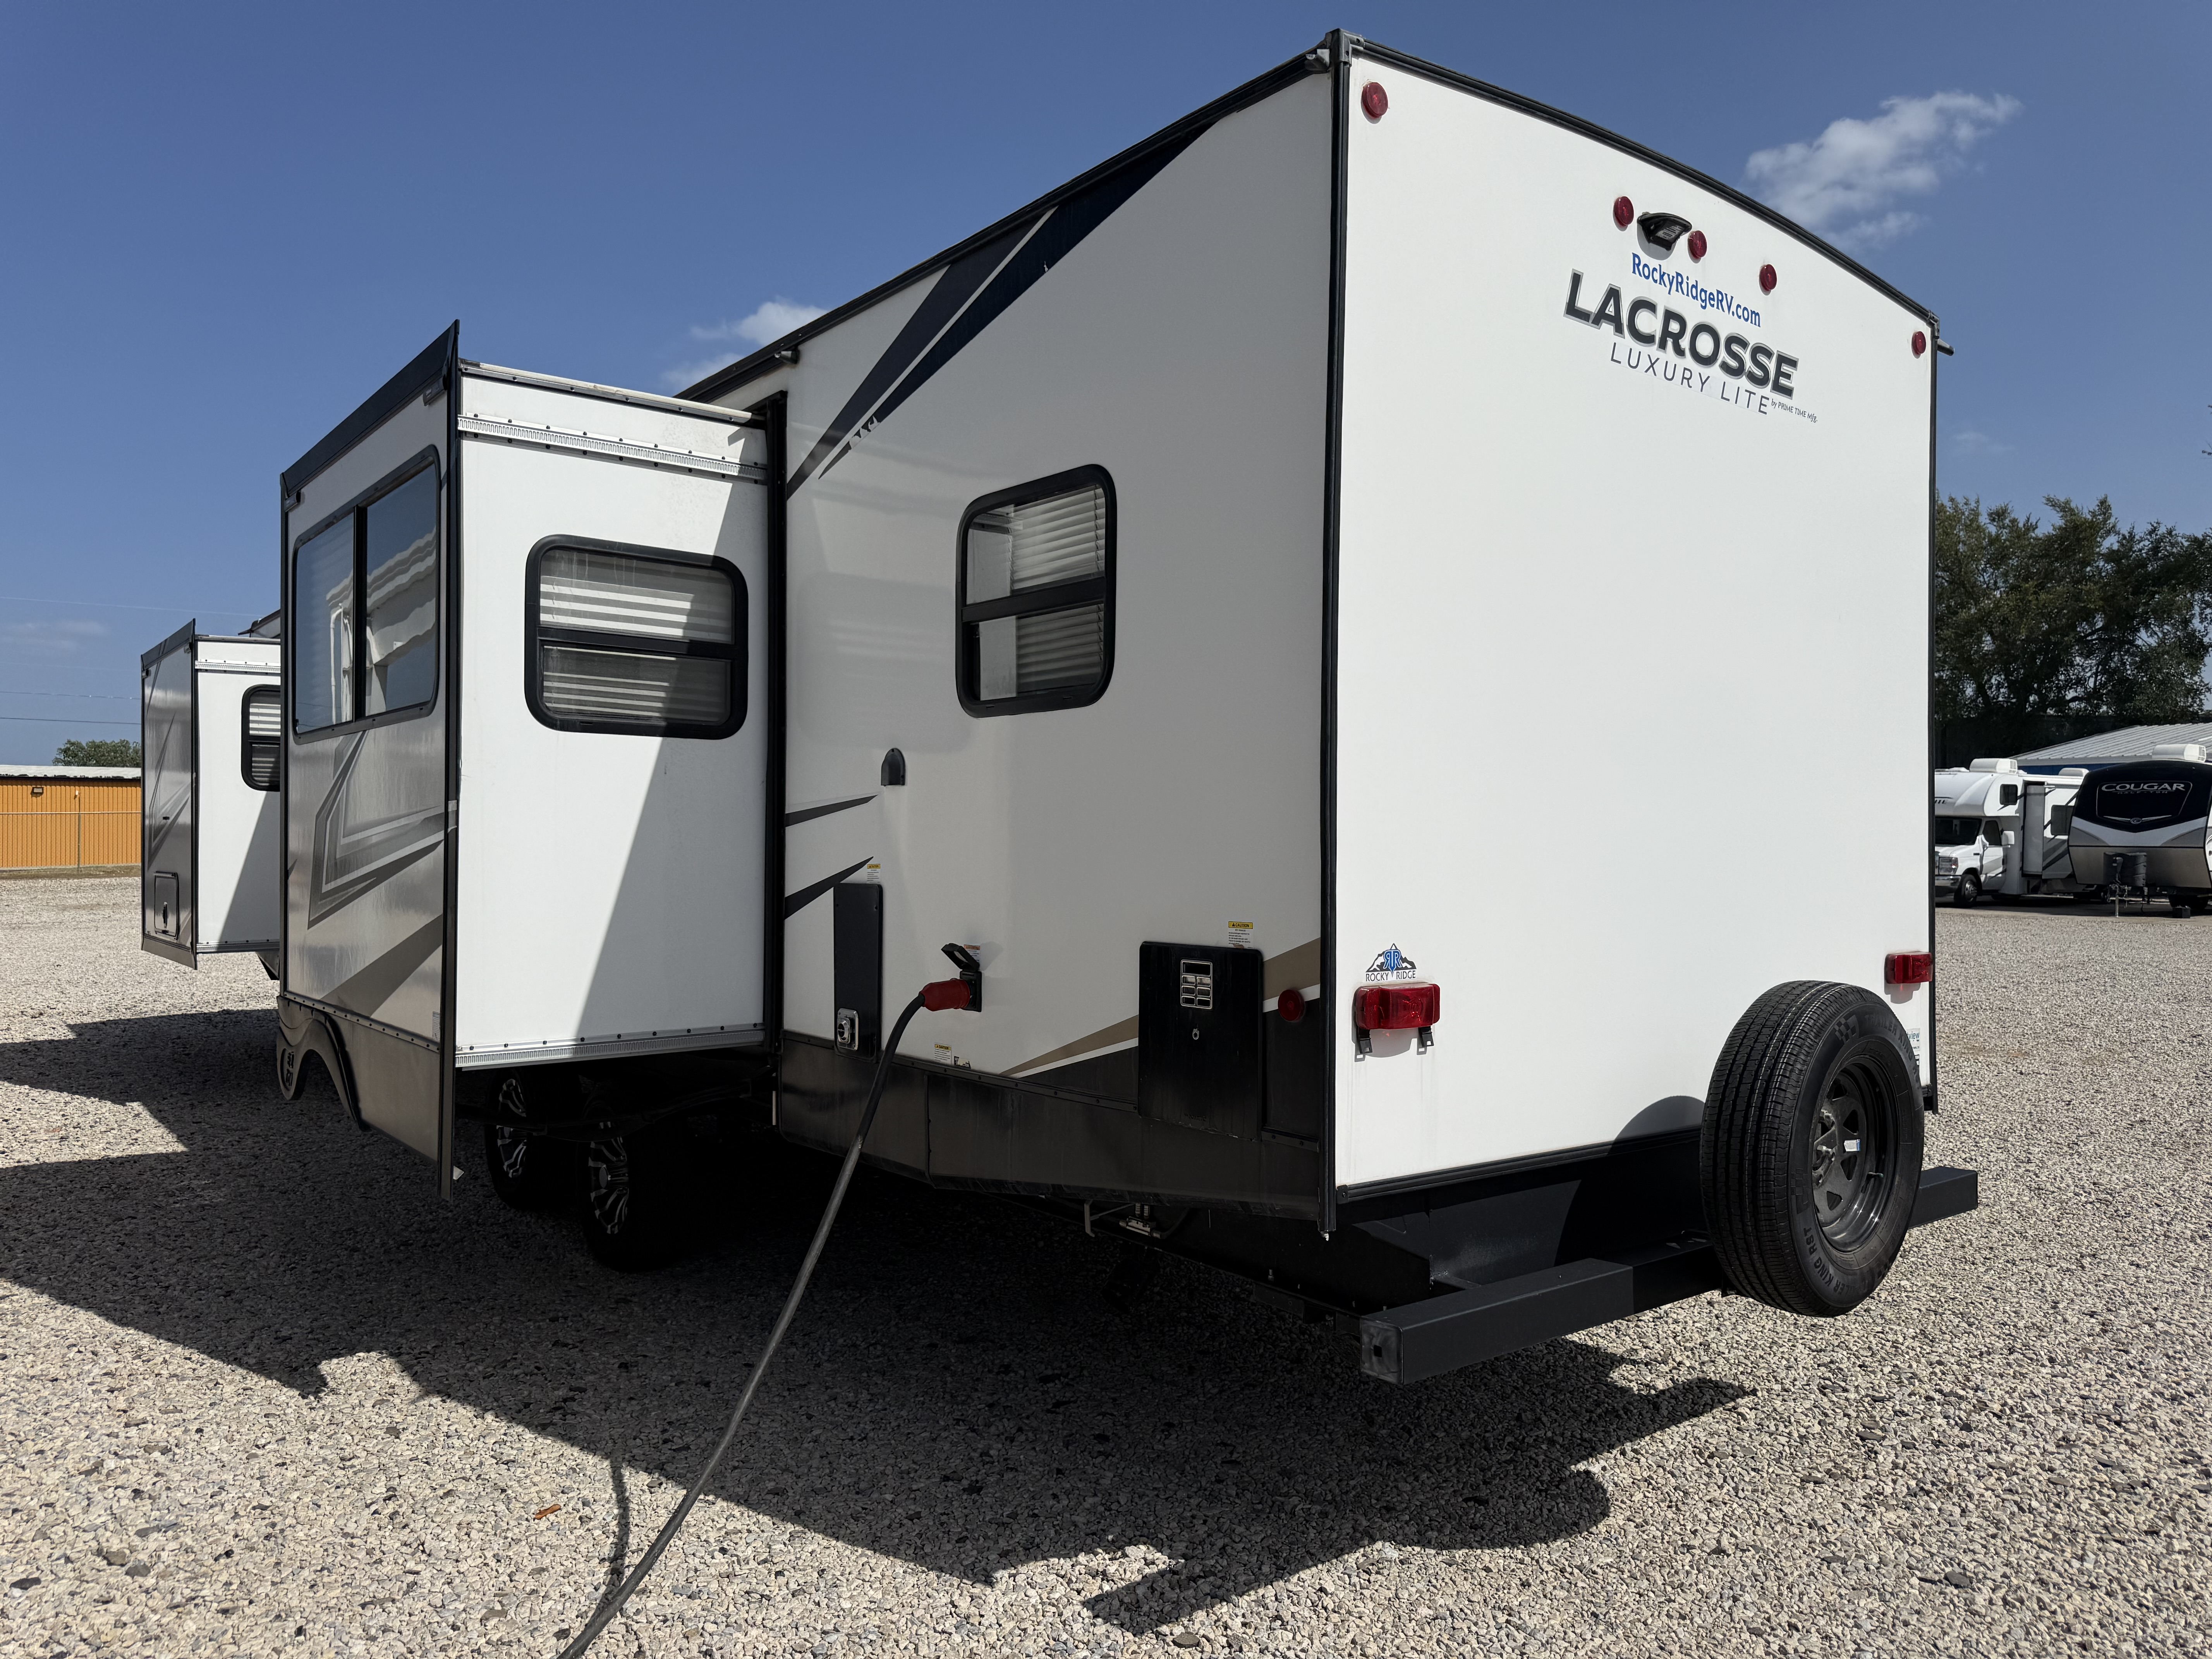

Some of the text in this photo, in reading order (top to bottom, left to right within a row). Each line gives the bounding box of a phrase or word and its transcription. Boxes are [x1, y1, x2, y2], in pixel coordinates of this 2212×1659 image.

[1632, 252, 1761, 328] RockyRidgeRV.com
[1563, 268, 1799, 400] LACROSSE
[1611, 342, 1769, 415] LUXURY LITE
[1771, 398, 1817, 423] by PRIME TIME Mfg.
[2101, 783, 2186, 791] COUGAR
[1366, 970, 1416, 982] ROCKY RIDGE
[1907, 1031, 1920, 1039] view
[1803, 1227, 1817, 1255] RST
[1814, 1257, 1834, 1286] KING
